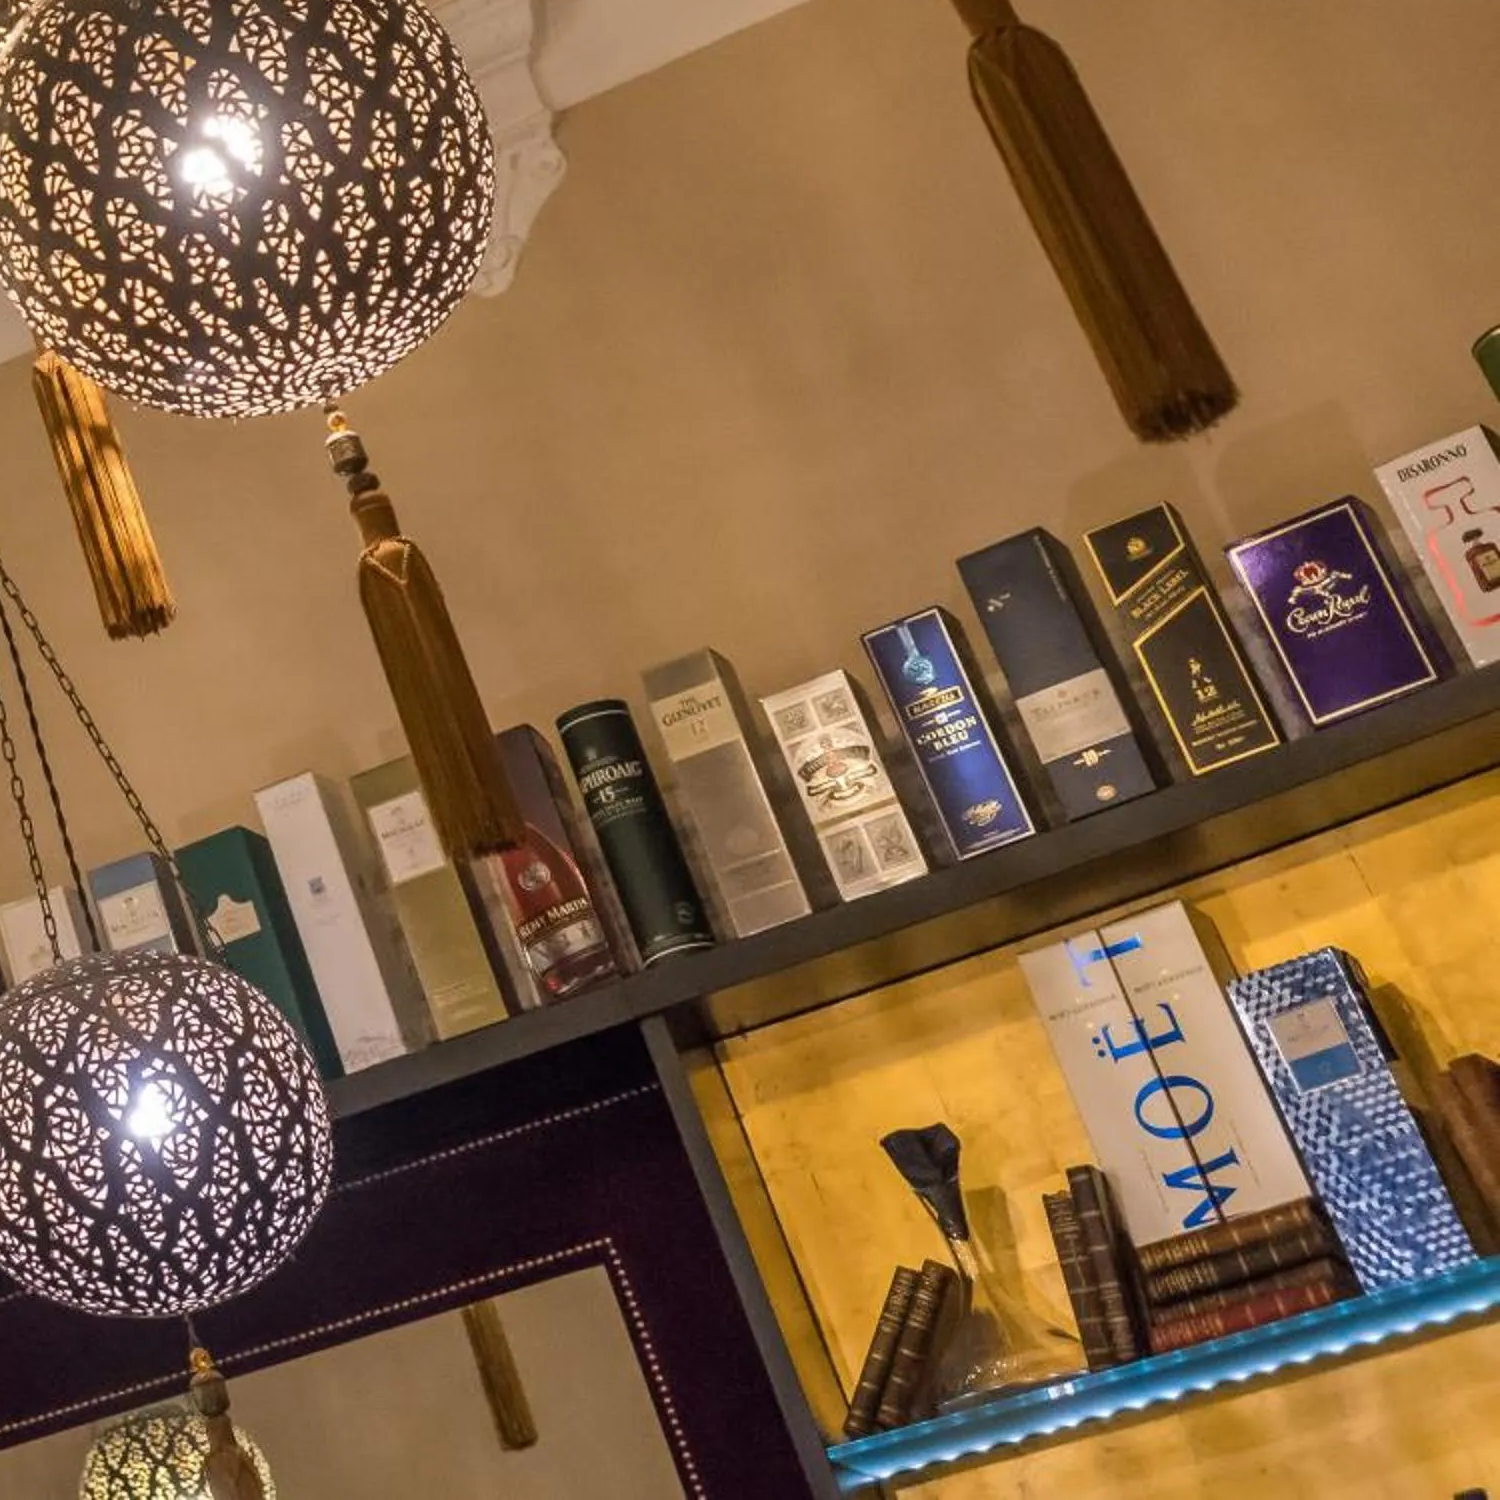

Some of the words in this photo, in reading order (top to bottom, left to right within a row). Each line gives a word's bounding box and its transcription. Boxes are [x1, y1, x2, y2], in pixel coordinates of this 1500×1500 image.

[1397, 444, 1468, 483] DISARONNO
[1286, 607, 1329, 633] Crown
[1318, 584, 1370, 625] Royal
[916, 715, 977, 745] CORDON
[933, 730, 969, 751] BLEU
[1063, 932, 1240, 1229] MOËT
